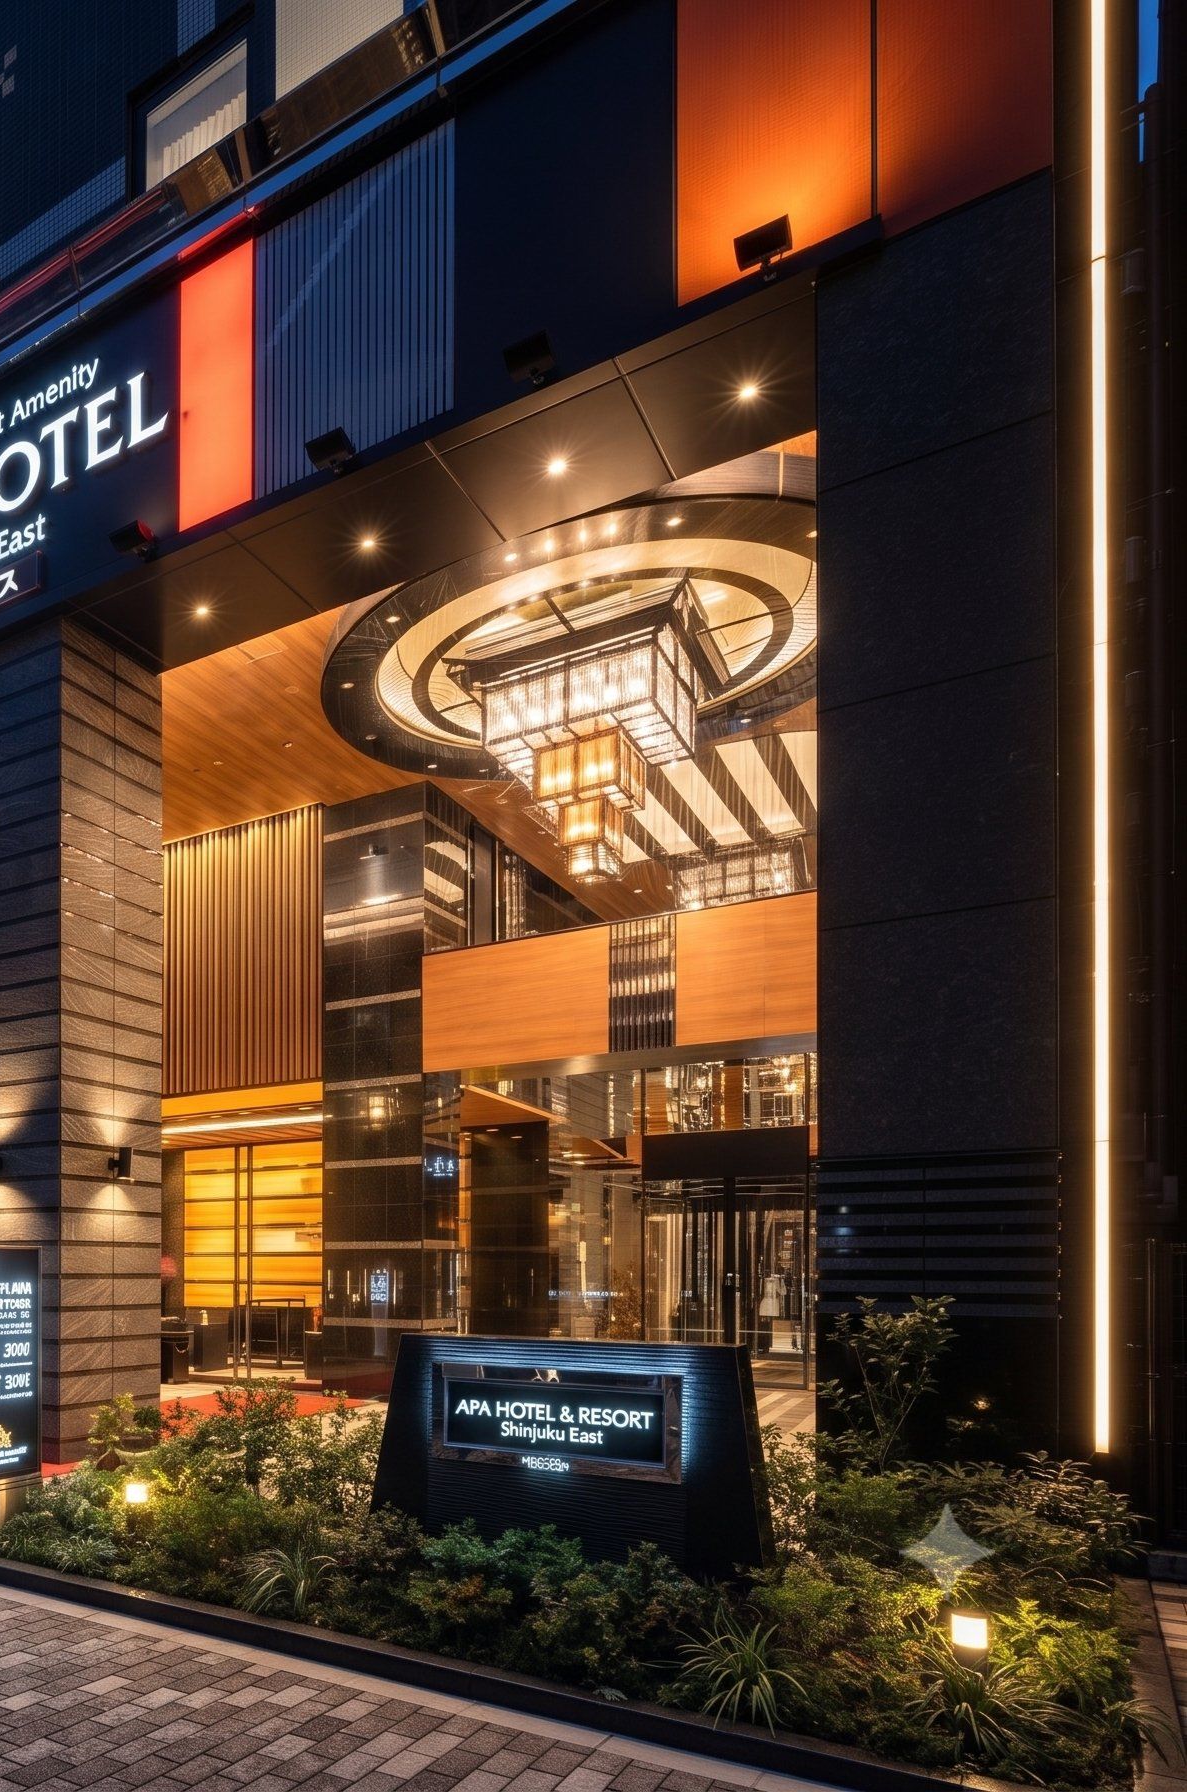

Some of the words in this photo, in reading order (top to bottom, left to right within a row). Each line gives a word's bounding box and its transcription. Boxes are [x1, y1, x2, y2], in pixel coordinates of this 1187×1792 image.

[9, 358, 100, 427] Amenity
[454, 1398, 491, 1417] APA
[495, 1401, 556, 1422] HOTEL
[559, 1406, 574, 1423] &
[578, 1407, 654, 1430] RESORT
[500, 1420, 565, 1443] Shinjuku
[569, 1427, 604, 1445] East
